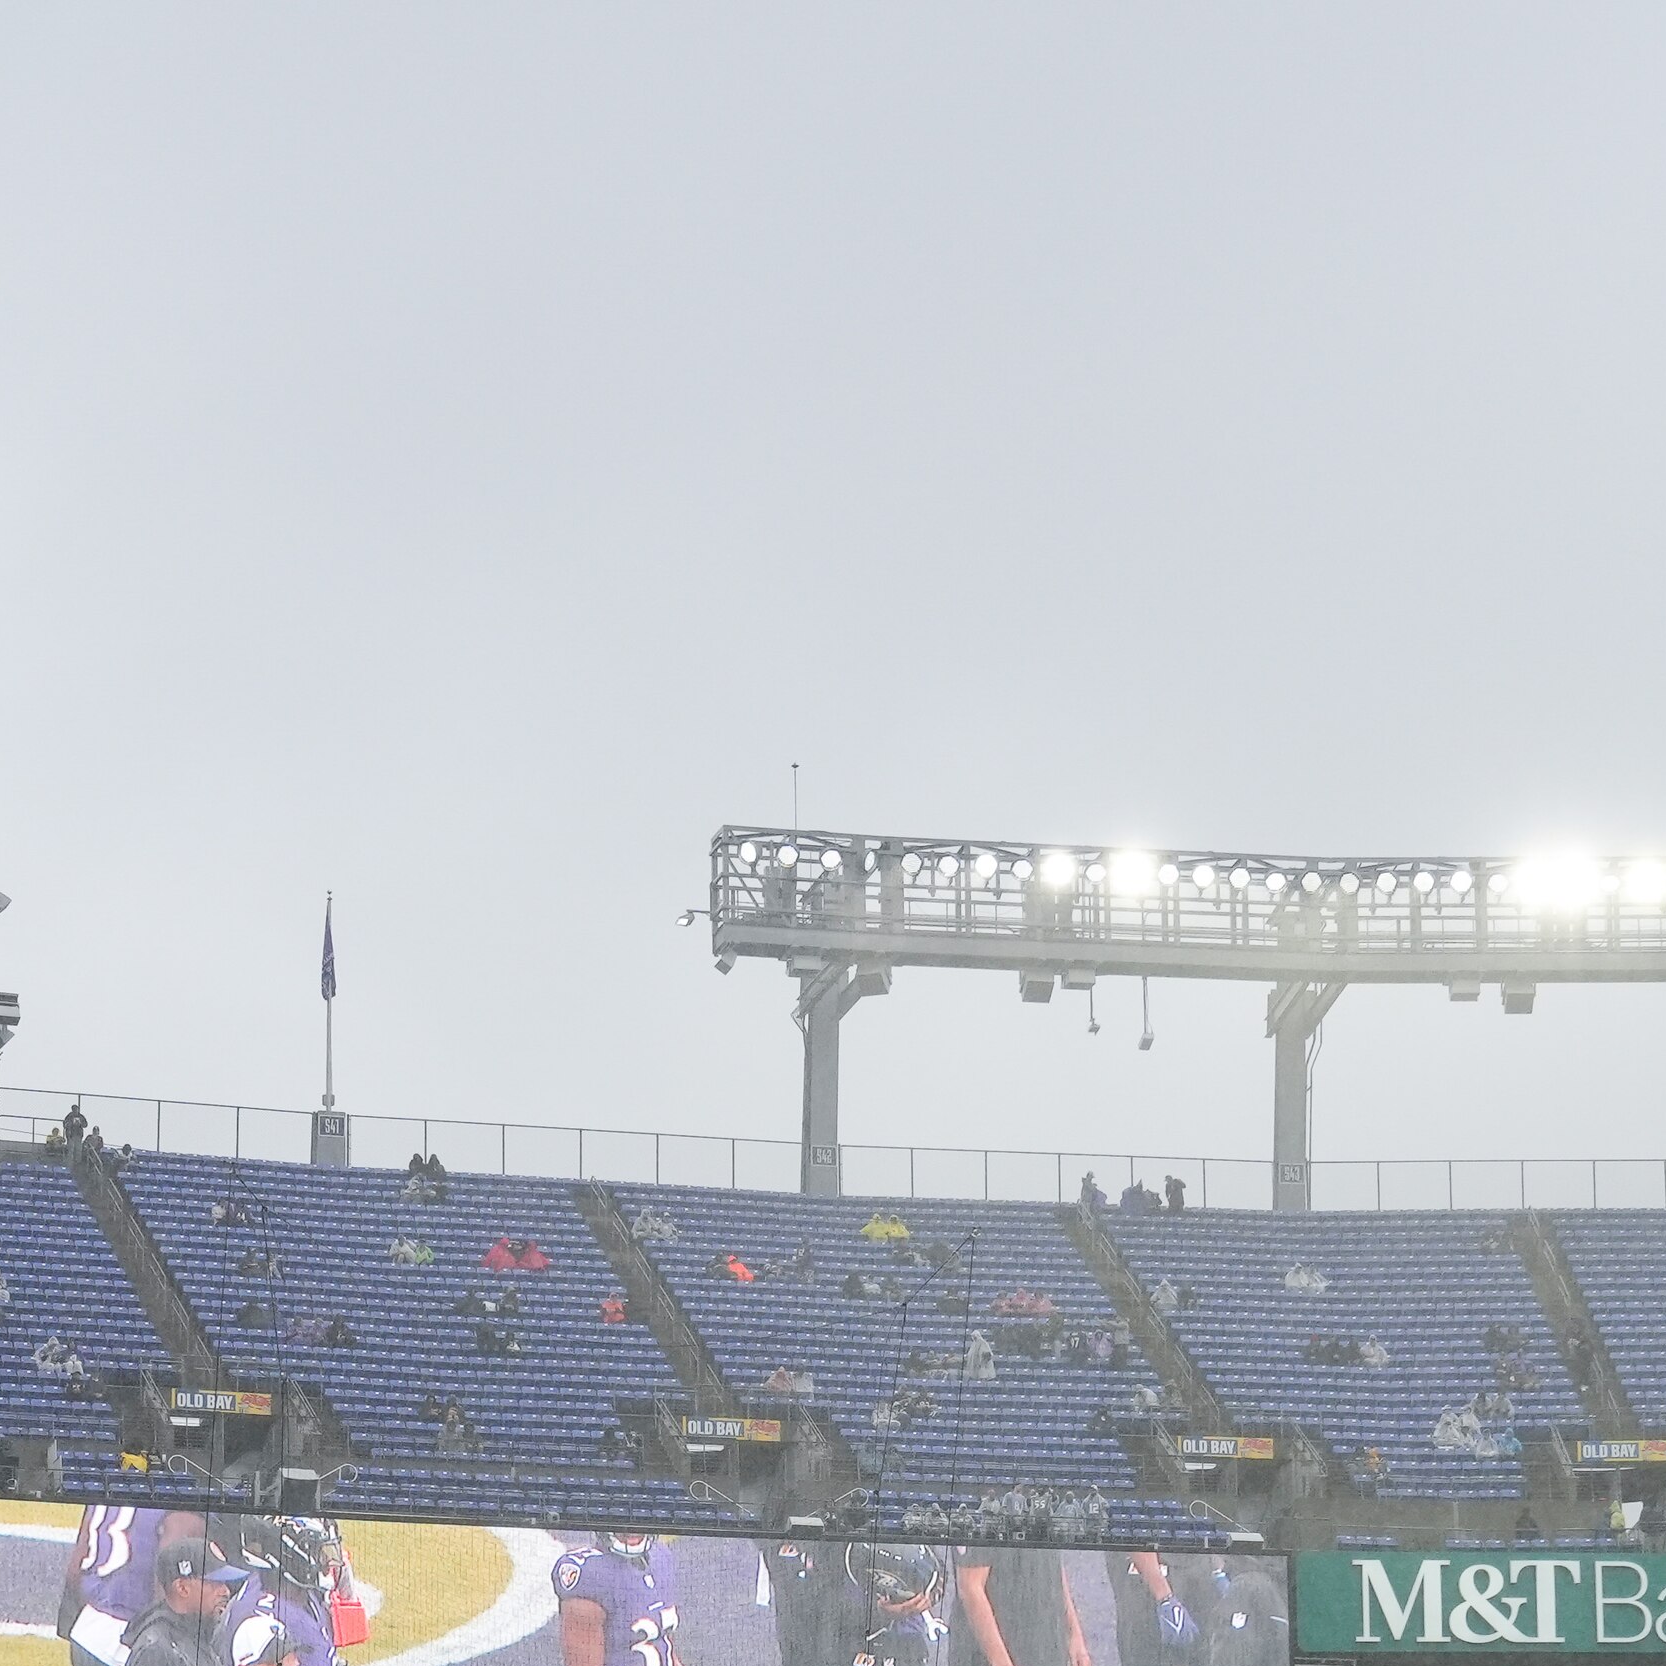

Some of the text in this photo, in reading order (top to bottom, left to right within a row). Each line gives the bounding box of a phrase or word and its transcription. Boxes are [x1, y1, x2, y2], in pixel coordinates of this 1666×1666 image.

[175, 1392, 234, 1412] OLD BAY
[687, 1421, 742, 1438] OLD BAY
[1183, 1440, 1236, 1456] OLD BAY
[1581, 1443, 1639, 1460] OLD BAY
[1351, 1558, 1580, 1643] M&T
